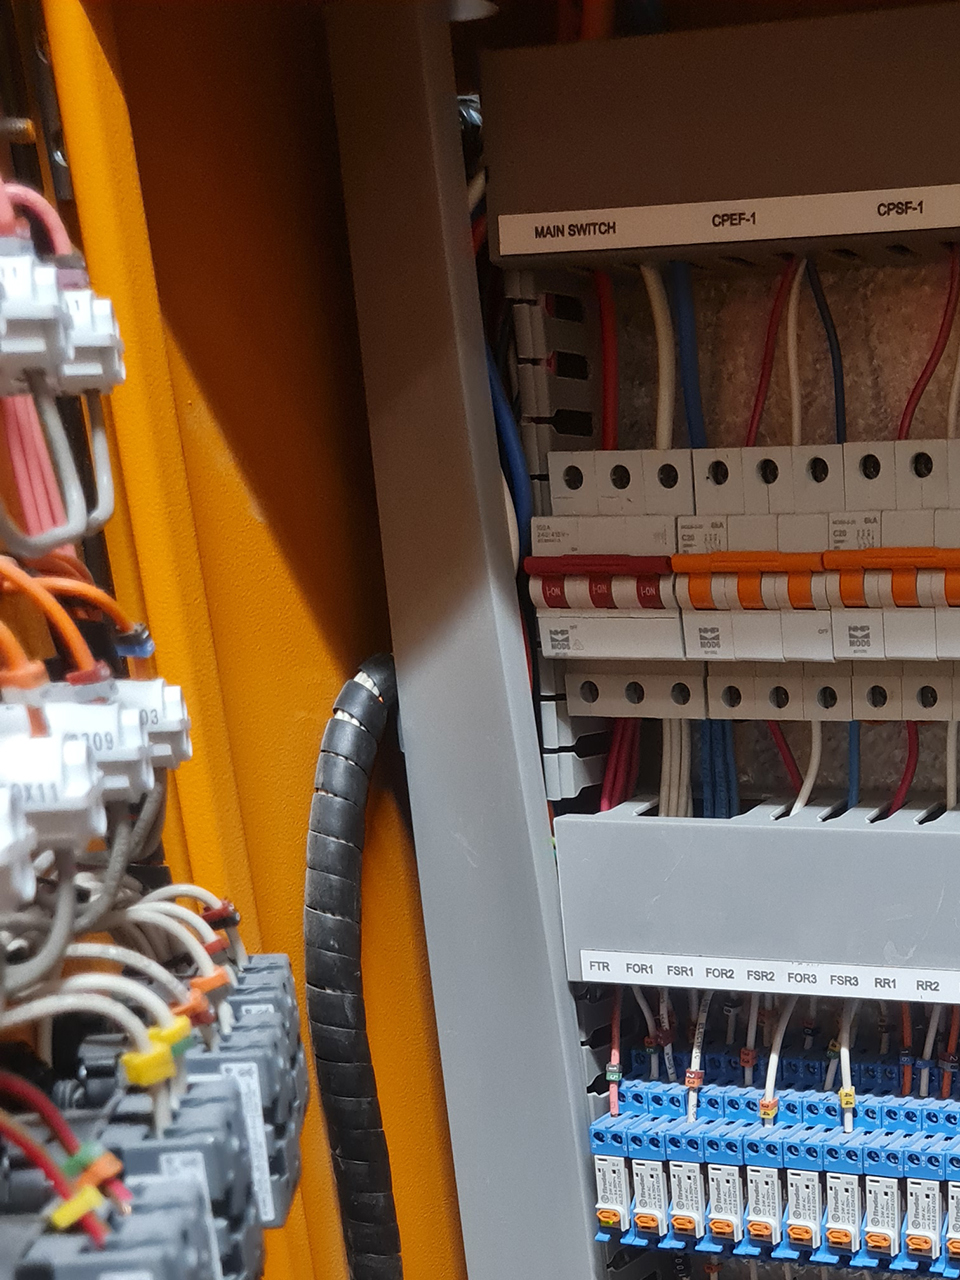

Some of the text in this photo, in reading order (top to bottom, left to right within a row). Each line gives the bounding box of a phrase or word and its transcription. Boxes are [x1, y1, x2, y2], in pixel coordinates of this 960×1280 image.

[876, 200, 924, 217] CPSF-1
[711, 211, 757, 228] CPEF-1
[534, 221, 616, 240] MAIN SWITCH
[590, 961, 610, 972] FTR
[626, 963, 654, 974] FOR1
[667, 966, 694, 976] FSR1
[706, 968, 735, 979] FOR2
[747, 970, 775, 981] FSR2
[787, 972, 818, 984] FOR3
[830, 975, 859, 986] FSR3
[874, 977, 897, 989] RR1
[916, 980, 940, 991] RR2
[686, 1073, 695, 1085] 23
